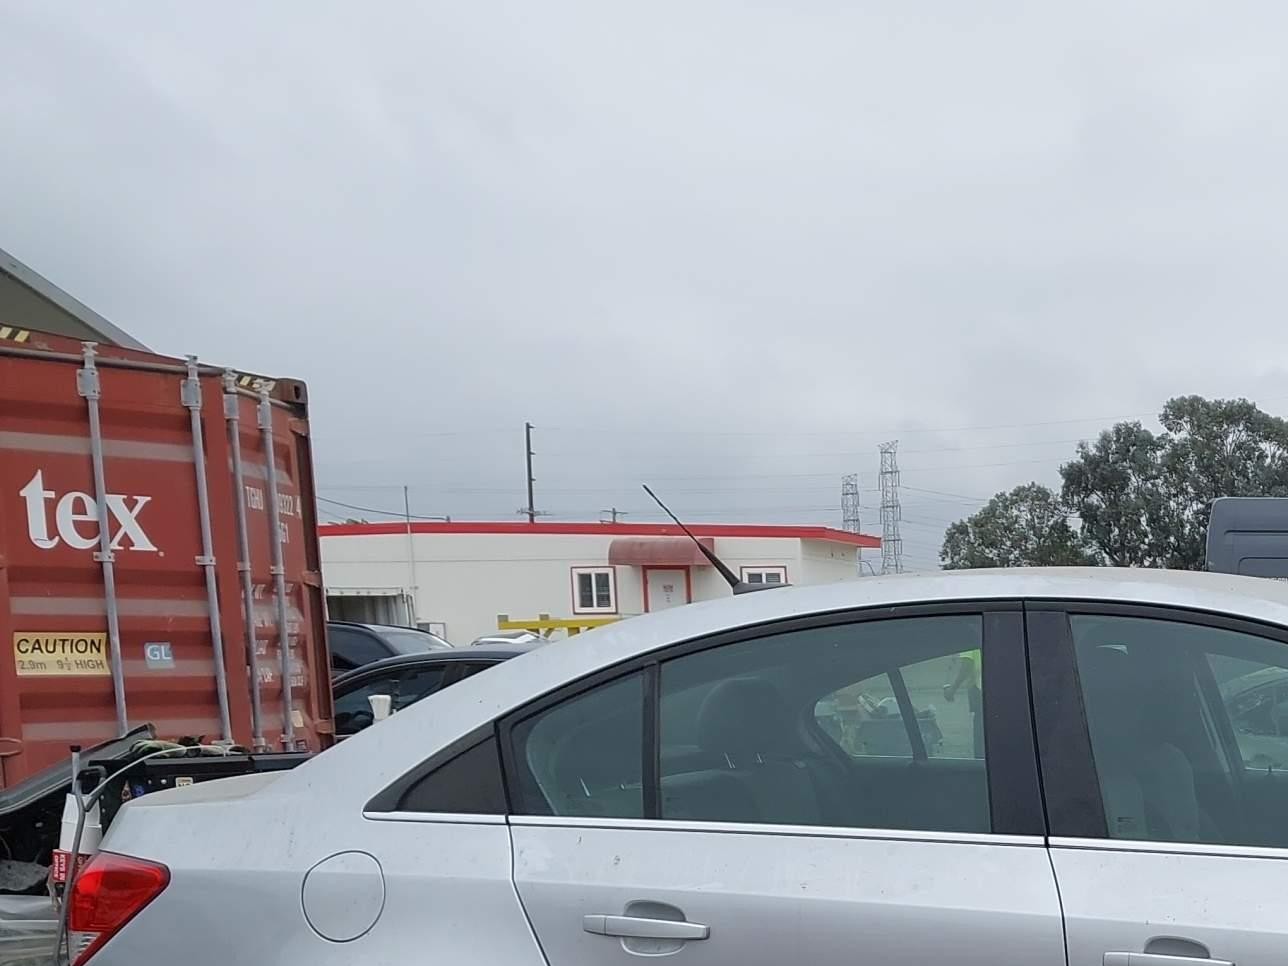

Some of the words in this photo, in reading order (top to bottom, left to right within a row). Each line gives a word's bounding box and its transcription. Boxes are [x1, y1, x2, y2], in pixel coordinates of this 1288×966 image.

[17, 638, 102, 654] CAUTION
[147, 645, 172, 660] GL
[75, 659, 105, 670] HIGH
